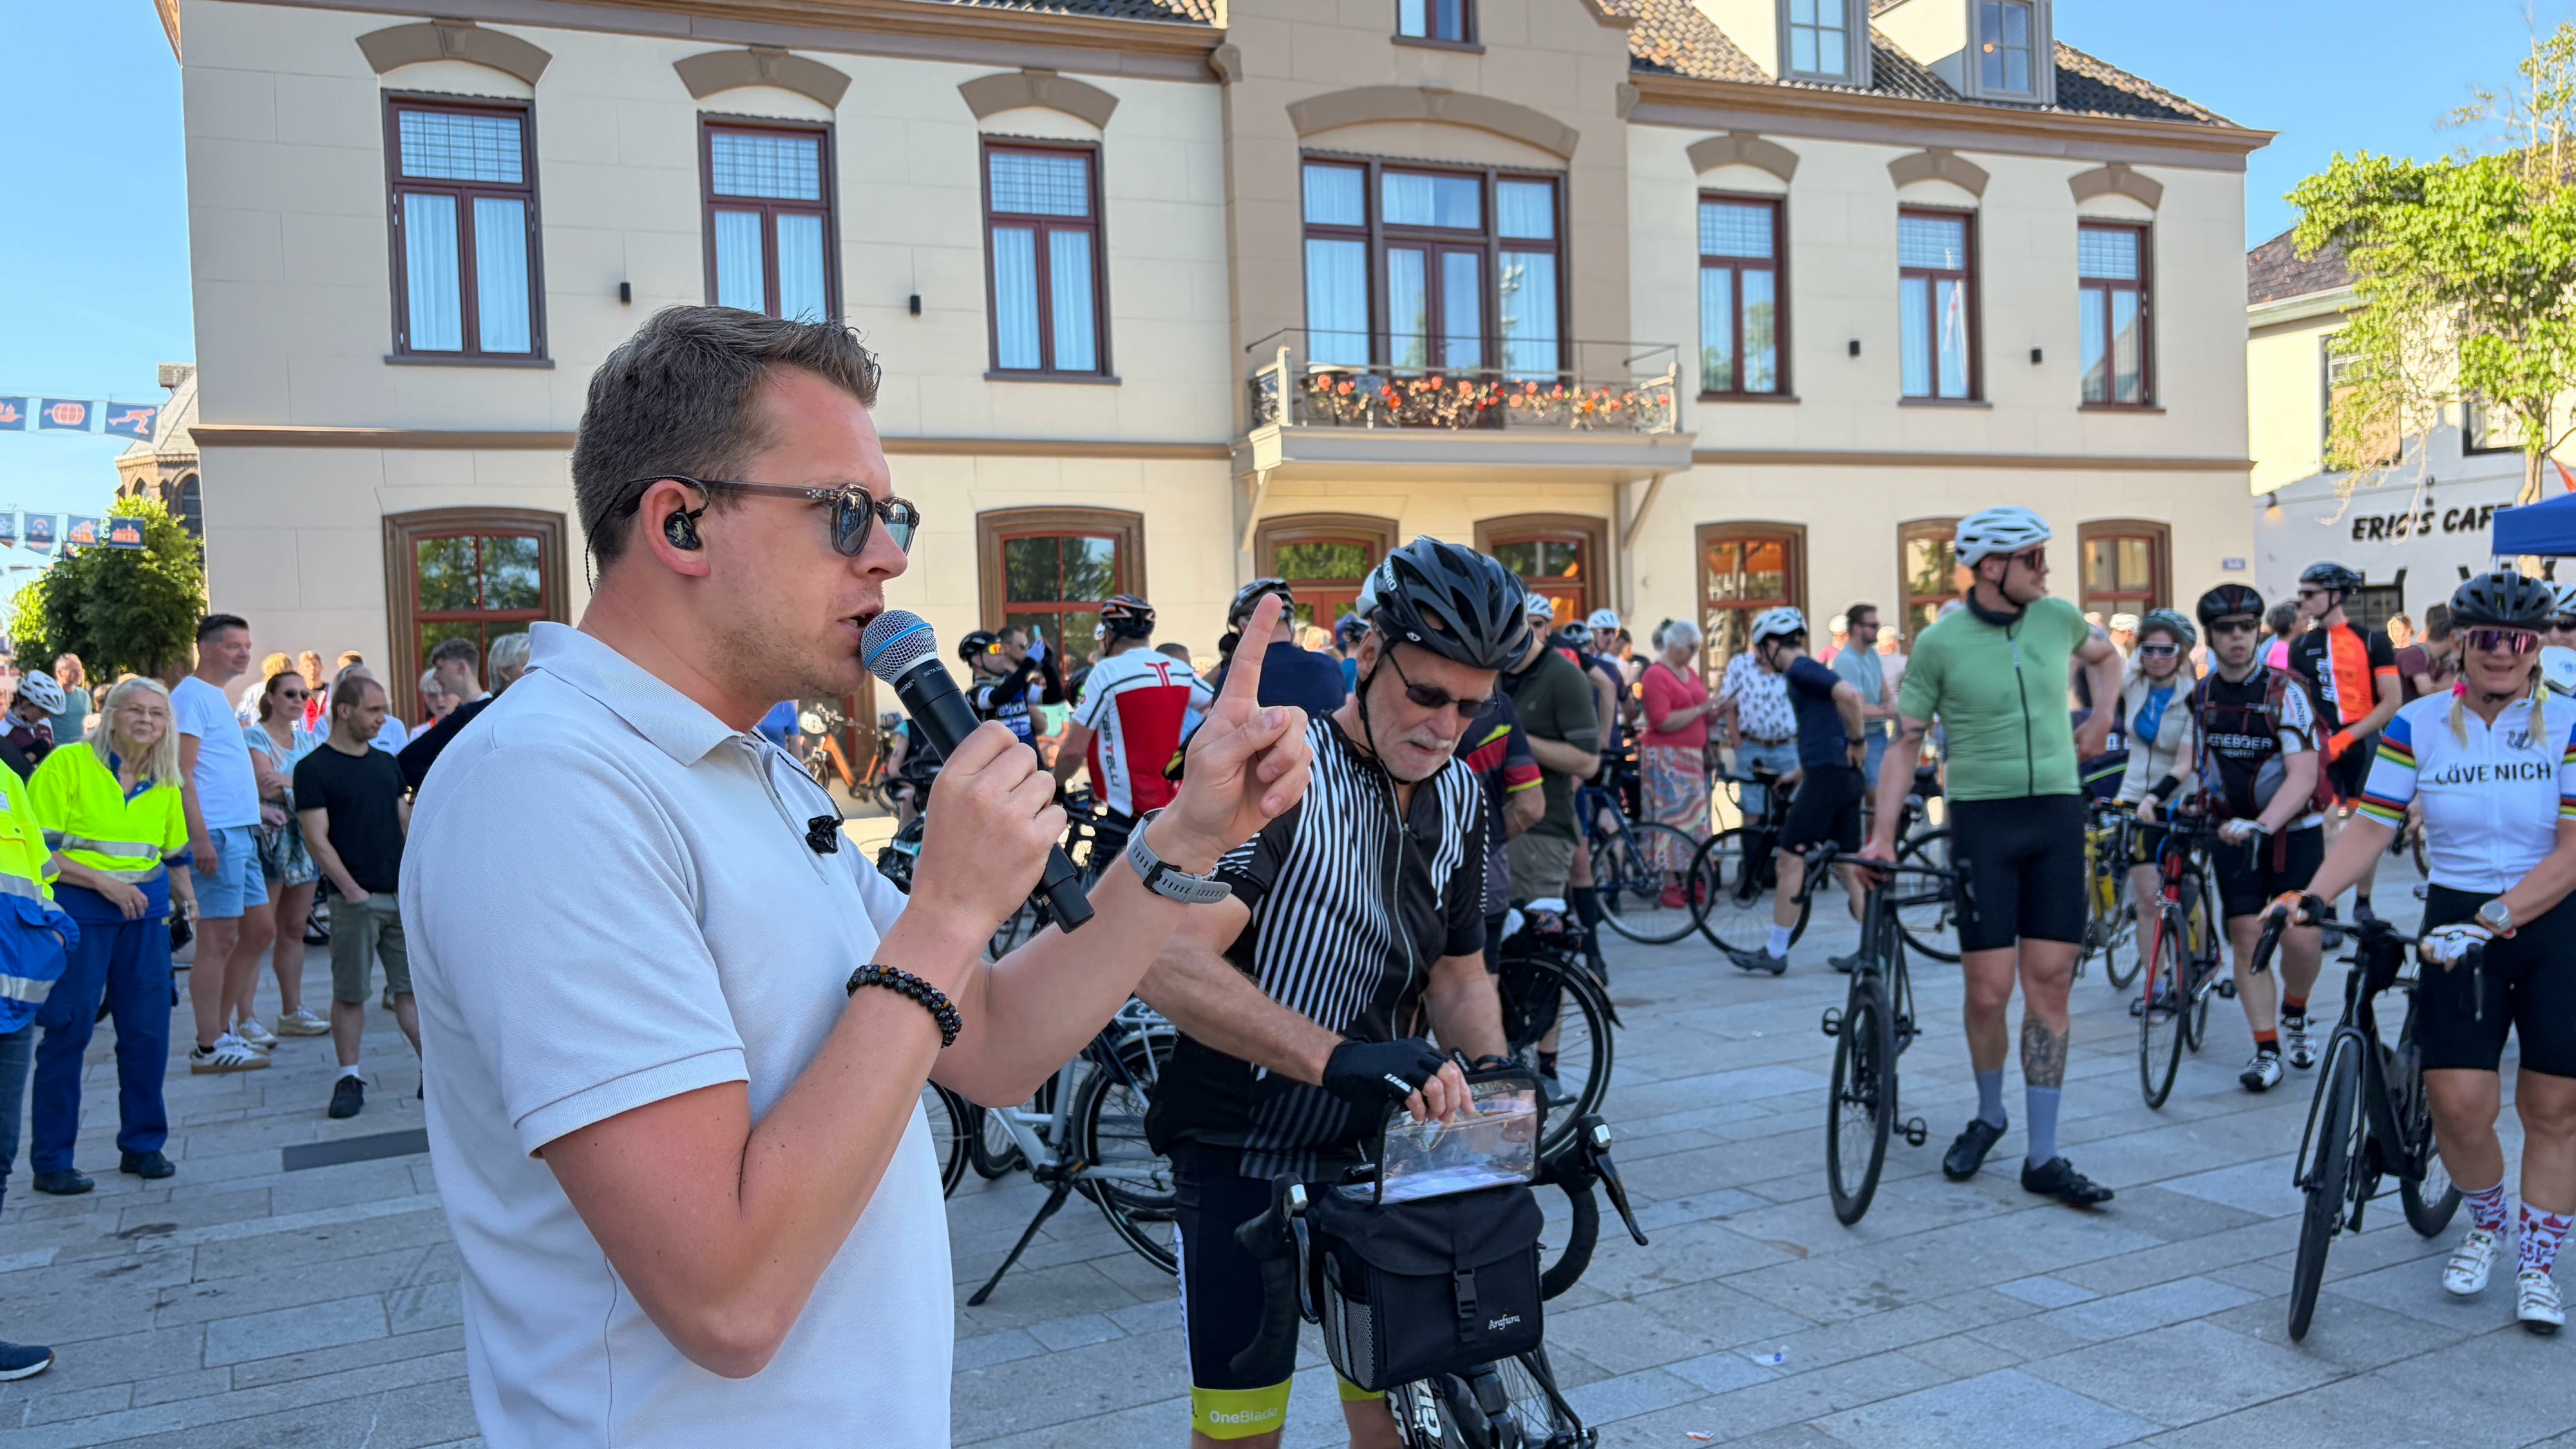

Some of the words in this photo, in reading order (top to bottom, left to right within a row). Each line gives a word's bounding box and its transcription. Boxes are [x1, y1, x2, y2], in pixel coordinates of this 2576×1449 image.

[2443, 504, 2512, 533] CAF
[1488, 1314, 1520, 1331] Arafura
[1209, 1407, 1278, 1423] OneBlade
